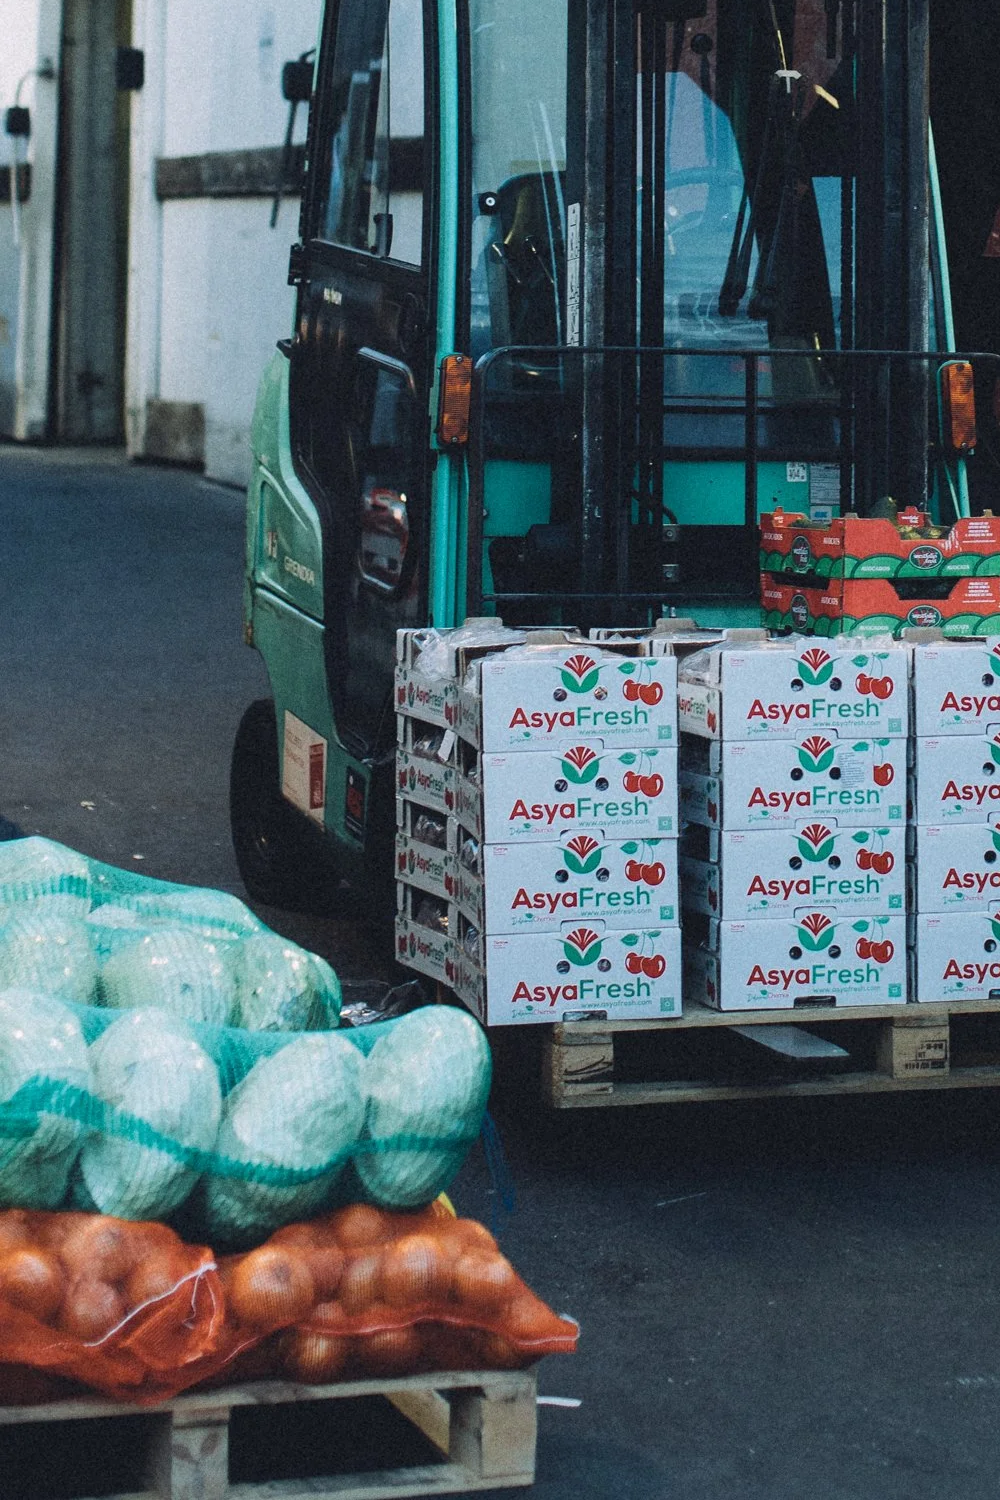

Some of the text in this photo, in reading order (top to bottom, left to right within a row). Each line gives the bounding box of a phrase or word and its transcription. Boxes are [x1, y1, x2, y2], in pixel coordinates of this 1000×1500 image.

[509, 705, 649, 732] AsyaFresh
[747, 698, 880, 724] AsyaFresh
[509, 796, 649, 824] AsyaFresh
[511, 886, 651, 914] AsyaFresh
[747, 874, 880, 900] AsyaFresh
[746, 963, 880, 990] AsyaFresh
[512, 978, 651, 1006] AsyaFresh
